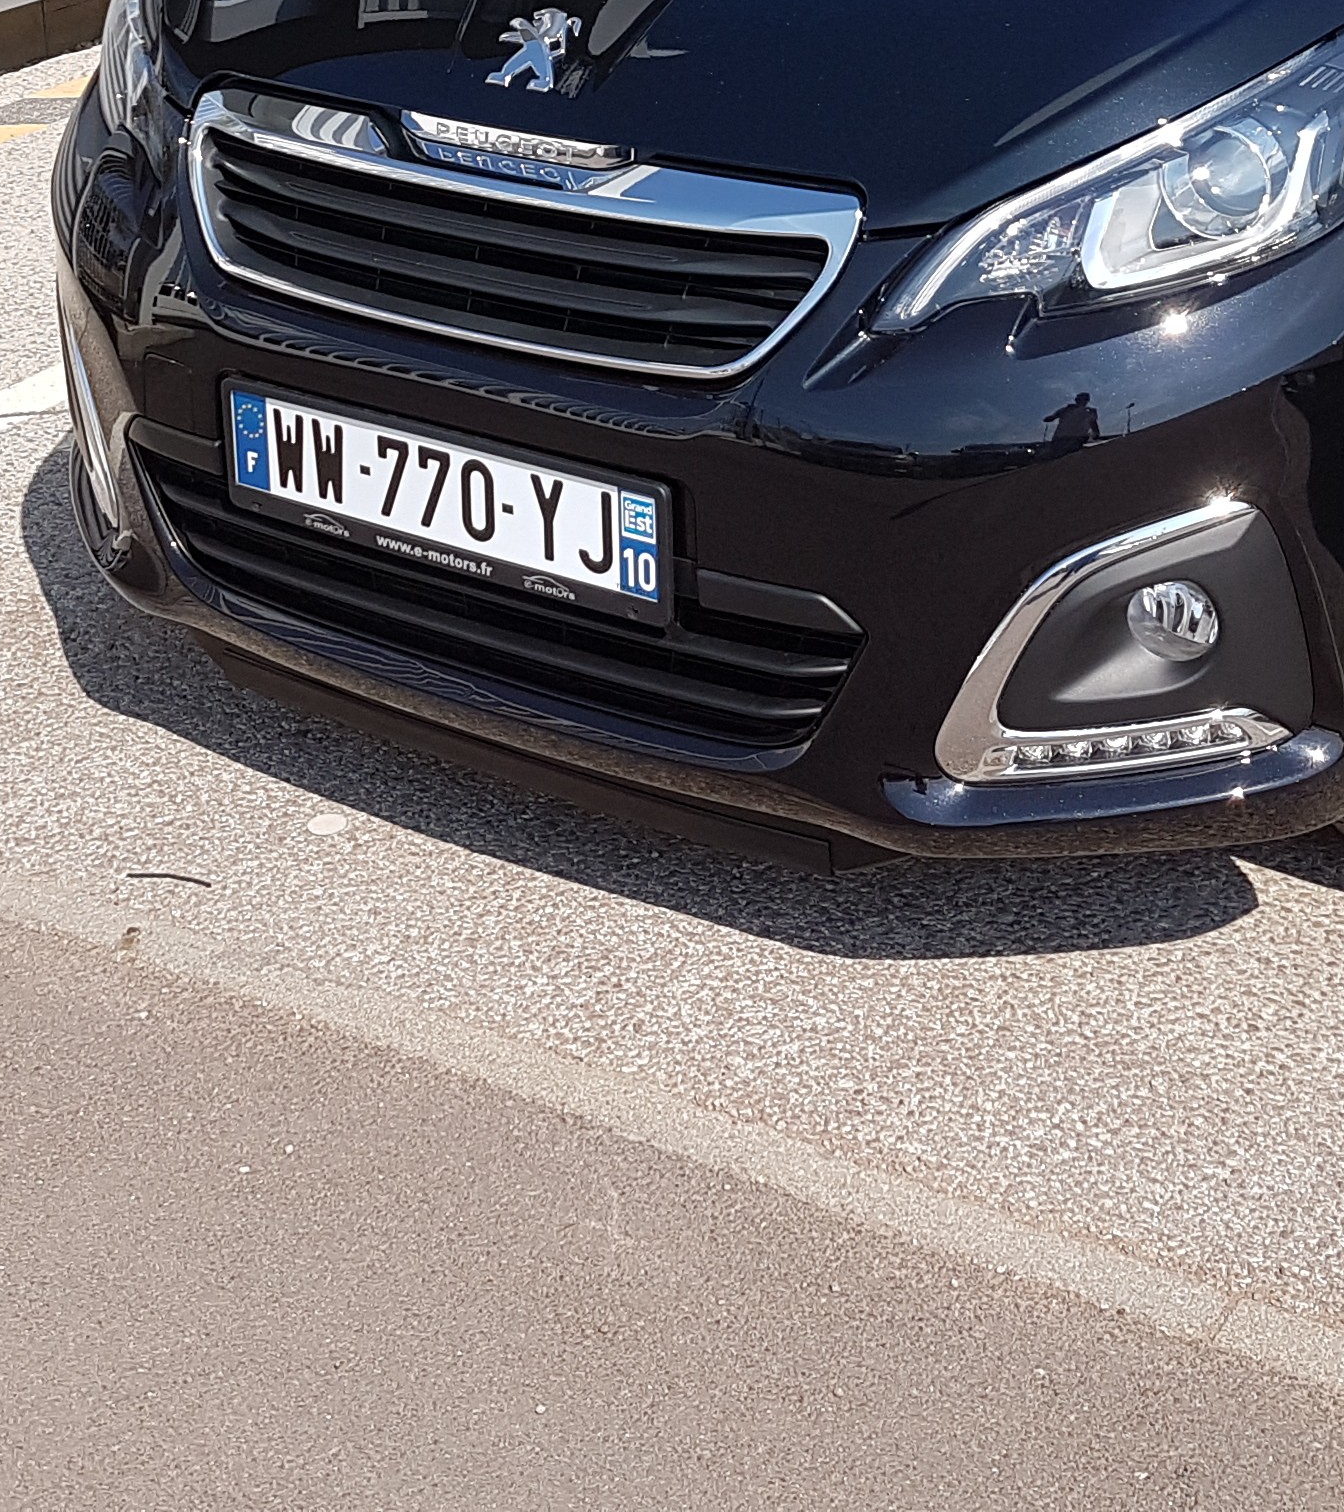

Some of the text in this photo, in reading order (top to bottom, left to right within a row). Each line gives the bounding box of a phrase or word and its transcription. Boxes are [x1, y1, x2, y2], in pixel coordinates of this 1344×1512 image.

[436, 121, 578, 165] PEUGEOT
[246, 450, 259, 473] F
[272, 407, 614, 575] WW-770-YJ
[624, 499, 653, 516] Grand
[624, 510, 654, 534] Est
[375, 534, 494, 577] www.e-motors.fr
[622, 547, 657, 592] 10
